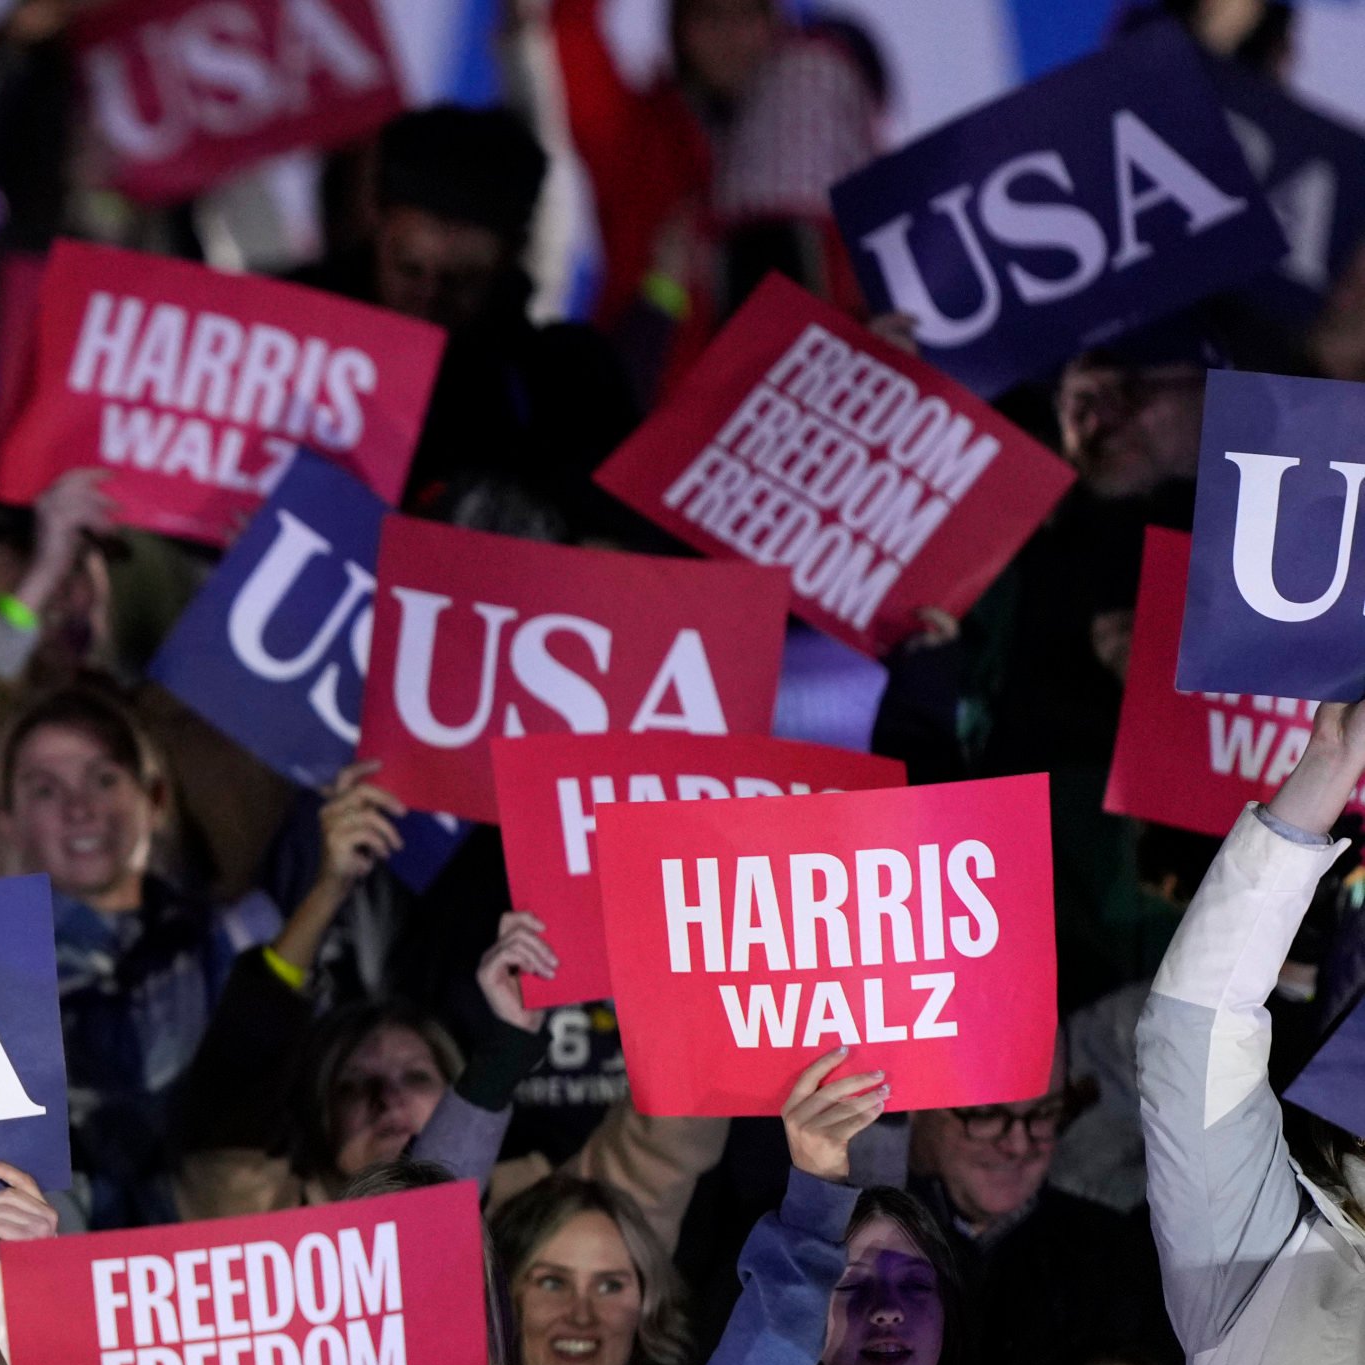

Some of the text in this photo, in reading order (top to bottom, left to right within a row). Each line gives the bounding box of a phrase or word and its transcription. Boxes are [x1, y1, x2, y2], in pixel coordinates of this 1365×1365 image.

[91, 0, 384, 160] USA
[862, 110, 1245, 349] USA
[70, 291, 378, 449] HARRIS
[767, 323, 1001, 501] FREEDOM
[664, 447, 900, 629] FREEDOM
[715, 382, 950, 563] FREEDOM
[1224, 451, 1365, 623] U
[391, 586, 727, 749] USA
[660, 839, 1000, 974] HARRIS
[718, 971, 958, 1049] WALZ
[91, 1221, 403, 1349] FREEDOM
